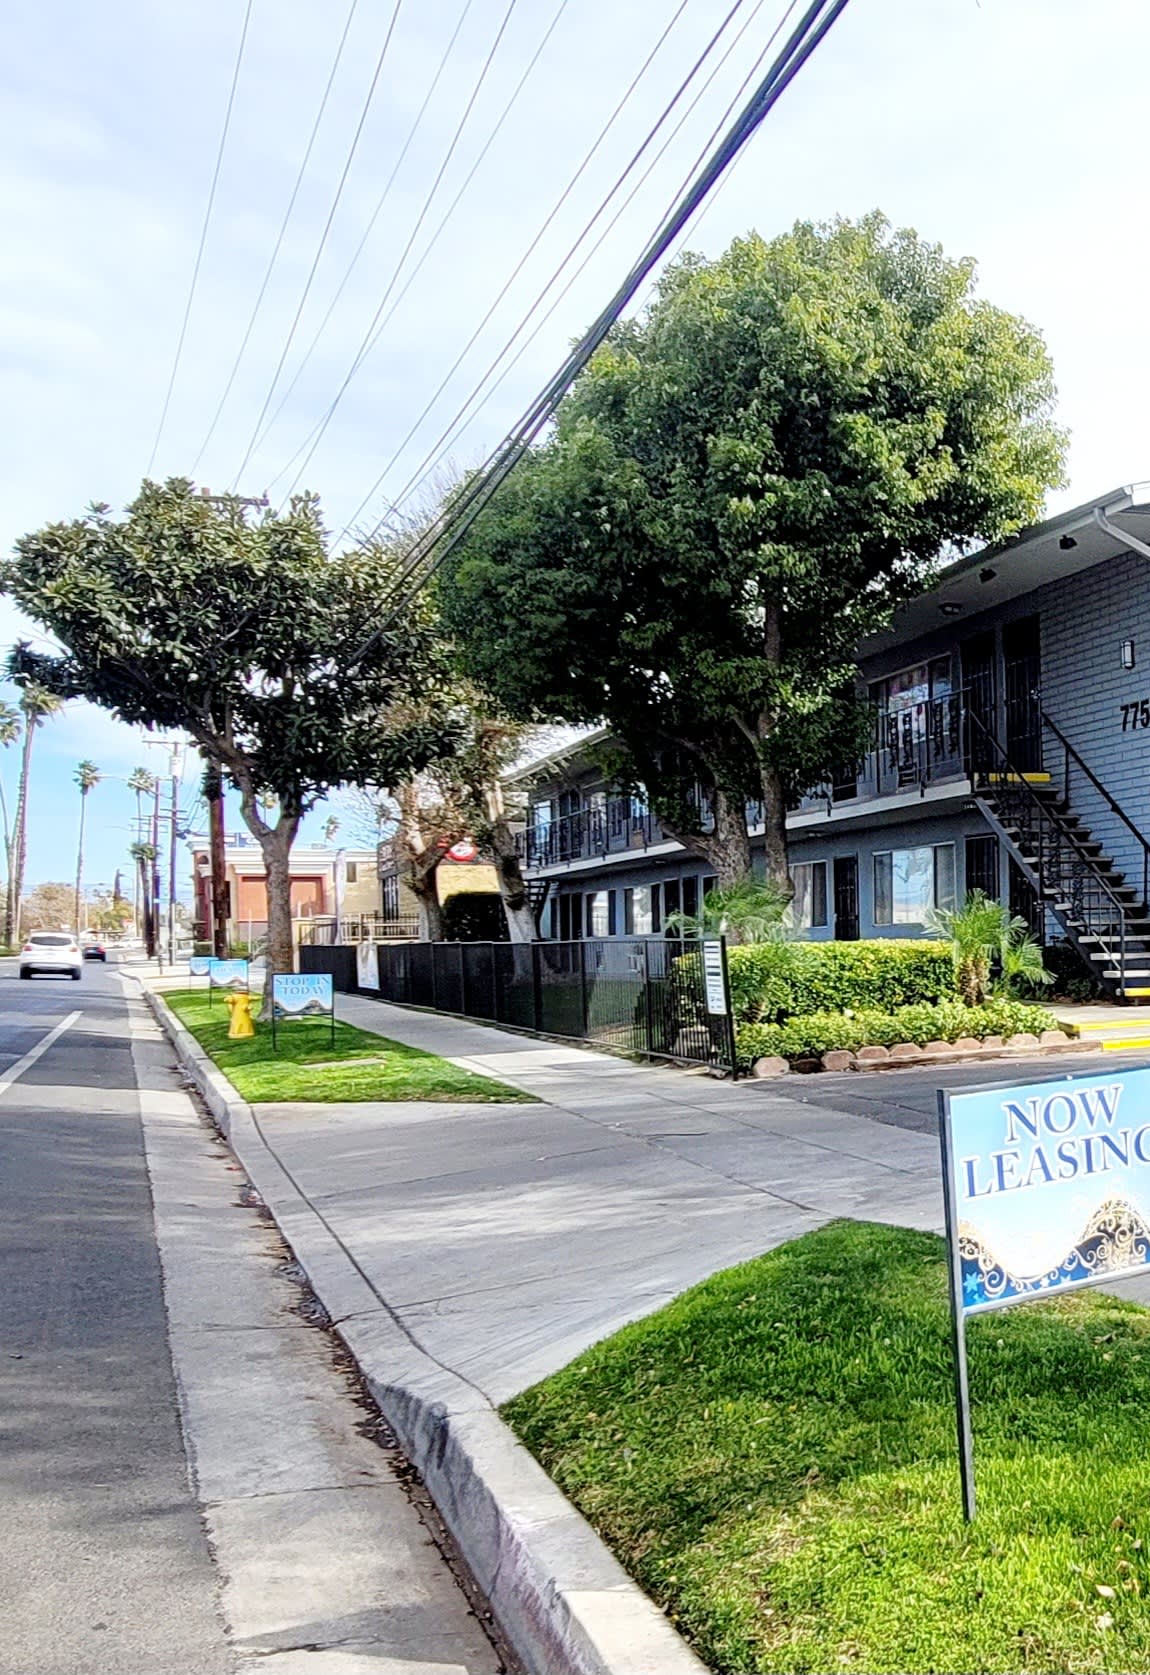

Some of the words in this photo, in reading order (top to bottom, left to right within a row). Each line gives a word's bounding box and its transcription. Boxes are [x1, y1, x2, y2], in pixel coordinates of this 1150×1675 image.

[275, 975, 310, 986] STOP
[316, 975, 330, 985] IN
[282, 985, 326, 995] TODAY
[1004, 1086, 1121, 1142] NOW
